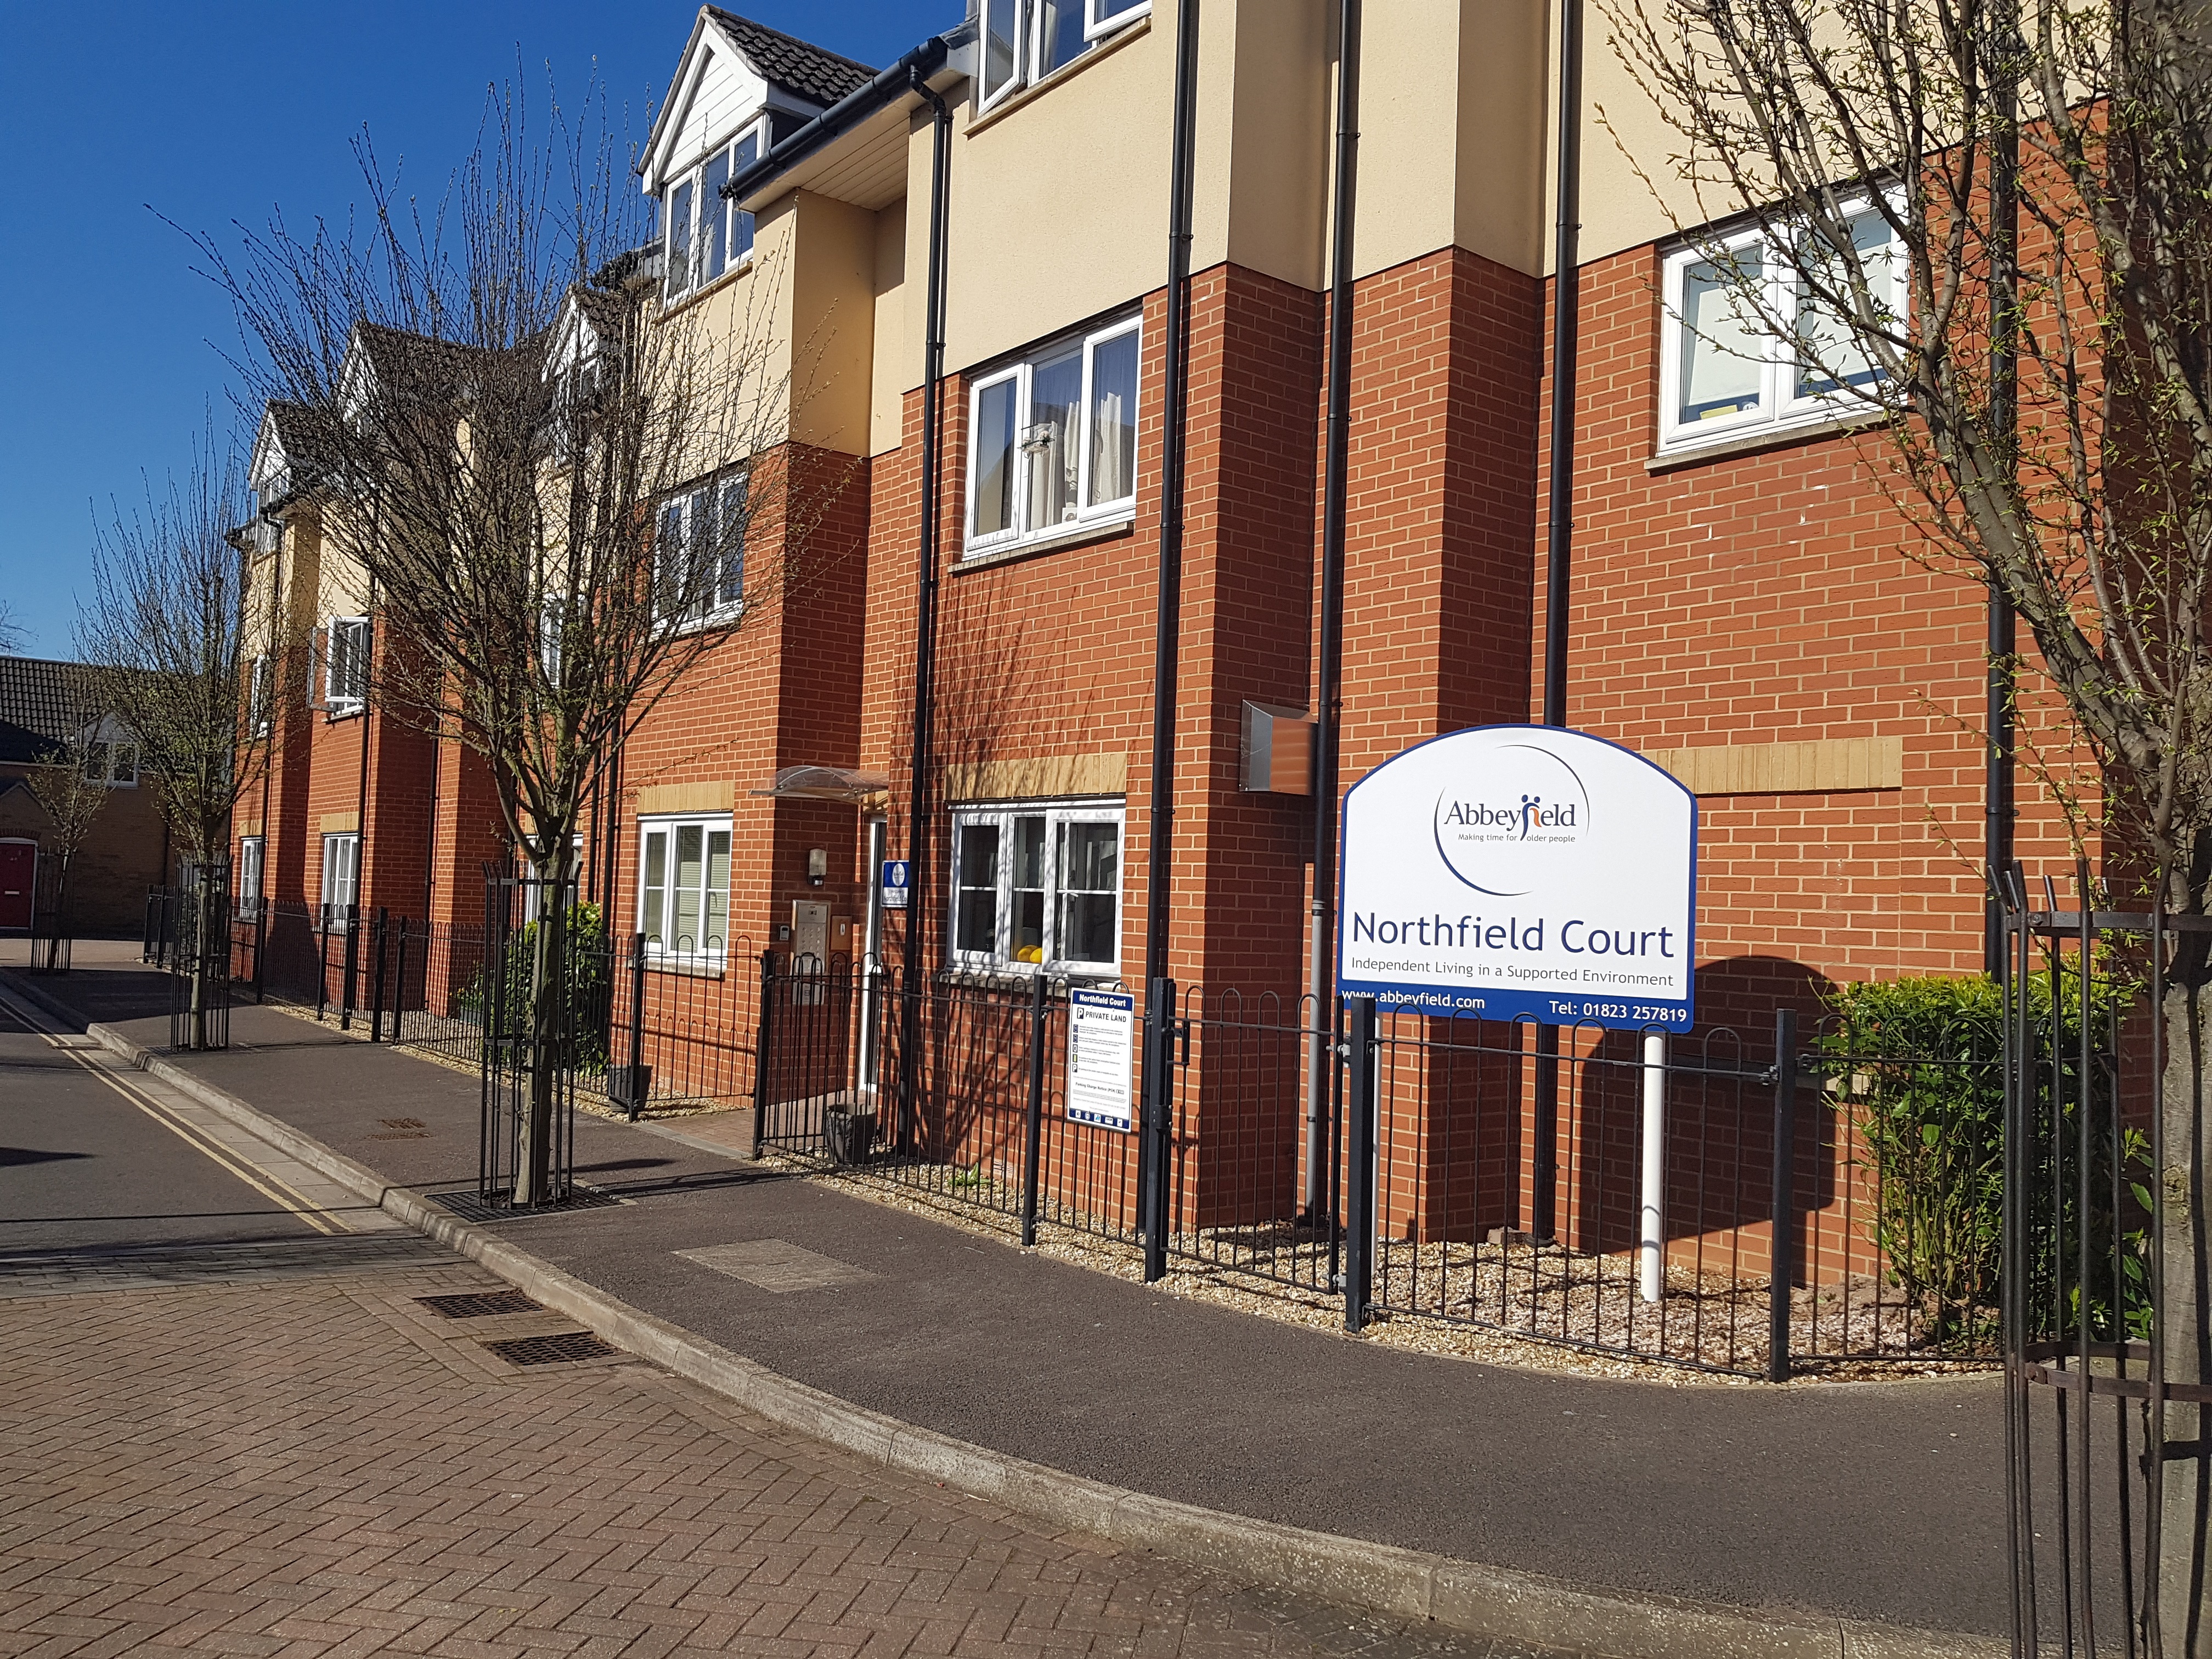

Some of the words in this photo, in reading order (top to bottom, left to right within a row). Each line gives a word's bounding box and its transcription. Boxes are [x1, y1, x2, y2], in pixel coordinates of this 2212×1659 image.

[1443, 794, 1577, 841] Abbeyfield
[1458, 833, 1484, 842] Making
[1549, 835, 1576, 843] people
[1353, 911, 1544, 951] Northfield
[1561, 919, 1674, 958] Court
[1351, 957, 1431, 973] Independent
[1435, 962, 1474, 978] Living
[1478, 964, 1491, 975] in
[1495, 968, 1503, 977] a
[1507, 966, 1578, 982] Supported
[1582, 969, 1674, 986] Environment
[1079, 994, 1108, 1005] Northfield
[1109, 997, 1126, 1007] Court
[1086, 1011, 1109, 1020] PRIVATE
[1111, 1014, 1126, 1022] LAND
[1549, 1001, 1578, 1015] Tel:
[1583, 1003, 1627, 1018] 01823
[1632, 1006, 1687, 1022] 257819
